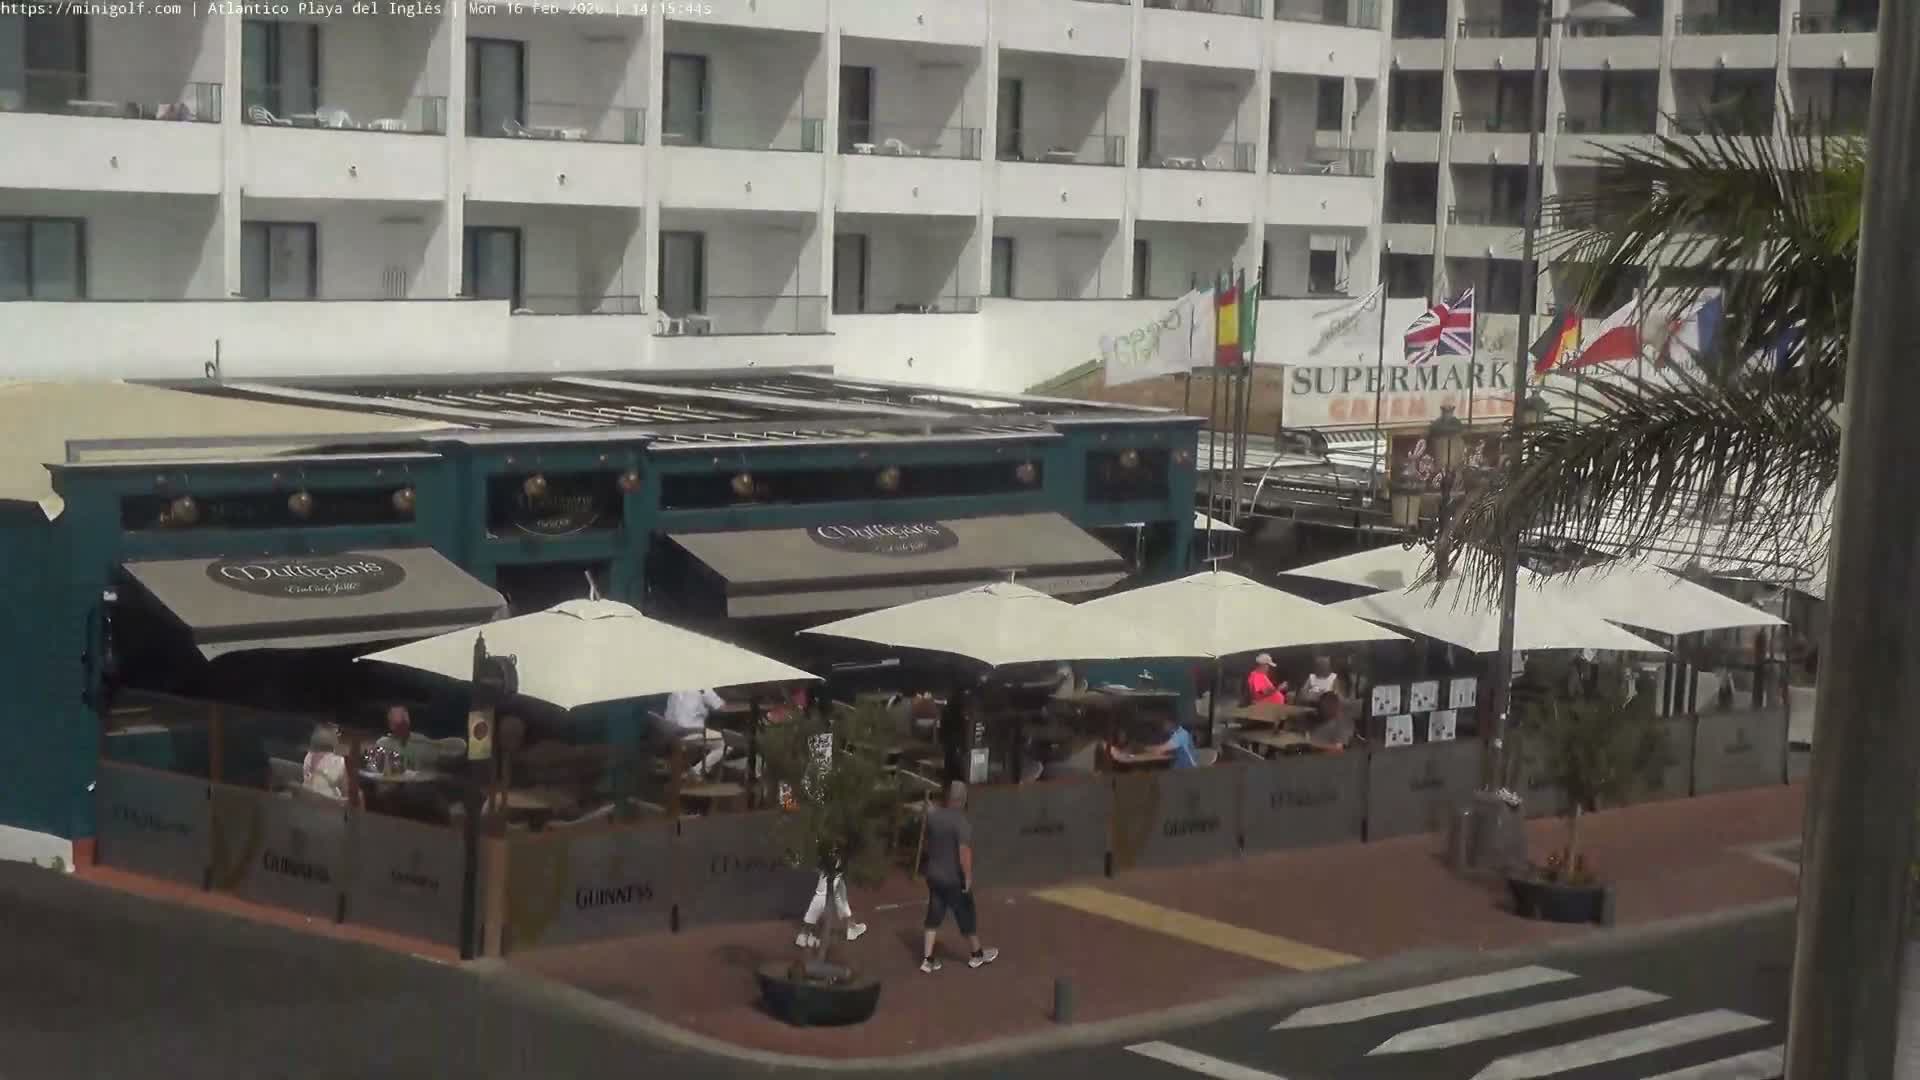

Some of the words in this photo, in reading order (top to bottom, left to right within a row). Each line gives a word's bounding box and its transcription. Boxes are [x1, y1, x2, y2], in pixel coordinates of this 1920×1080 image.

[1290, 361, 1514, 395] SUPERMARK
[220, 561, 382, 580] Mulligan's
[575, 883, 654, 910] GUINNESS
